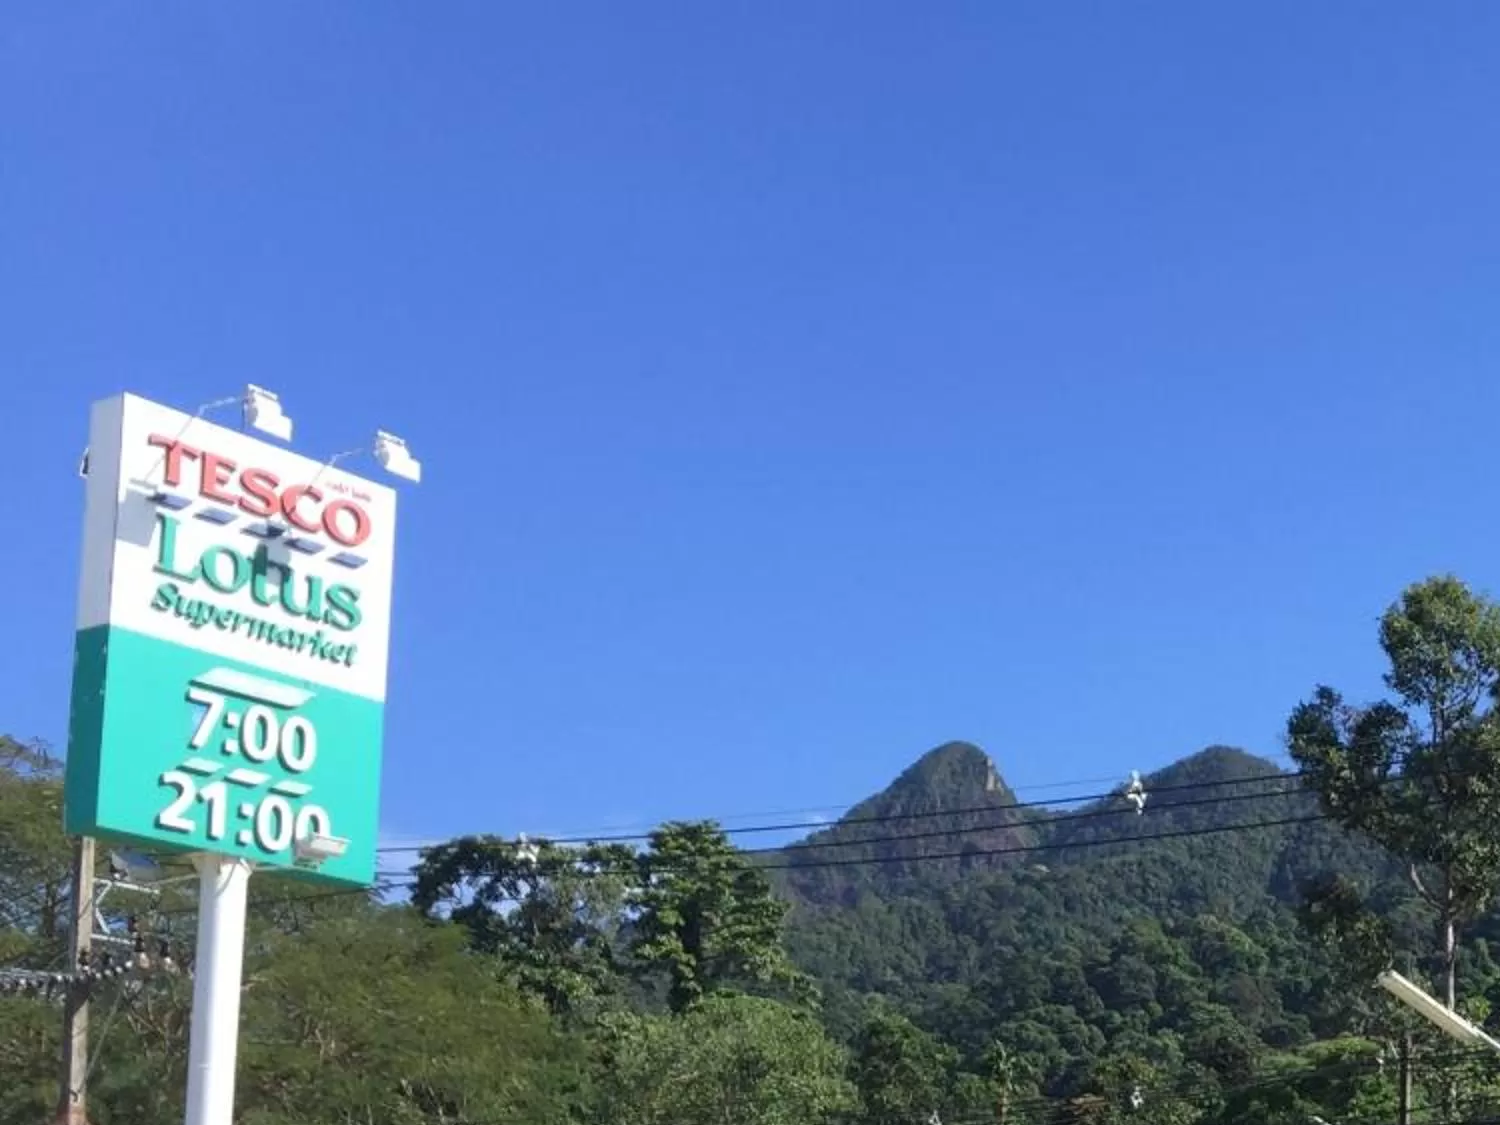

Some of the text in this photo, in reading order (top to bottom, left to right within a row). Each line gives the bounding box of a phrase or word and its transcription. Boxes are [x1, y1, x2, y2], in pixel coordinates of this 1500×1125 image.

[148, 433, 372, 547] TESCO
[151, 582, 358, 668] Supermarket
[187, 693, 316, 773] 7:00
